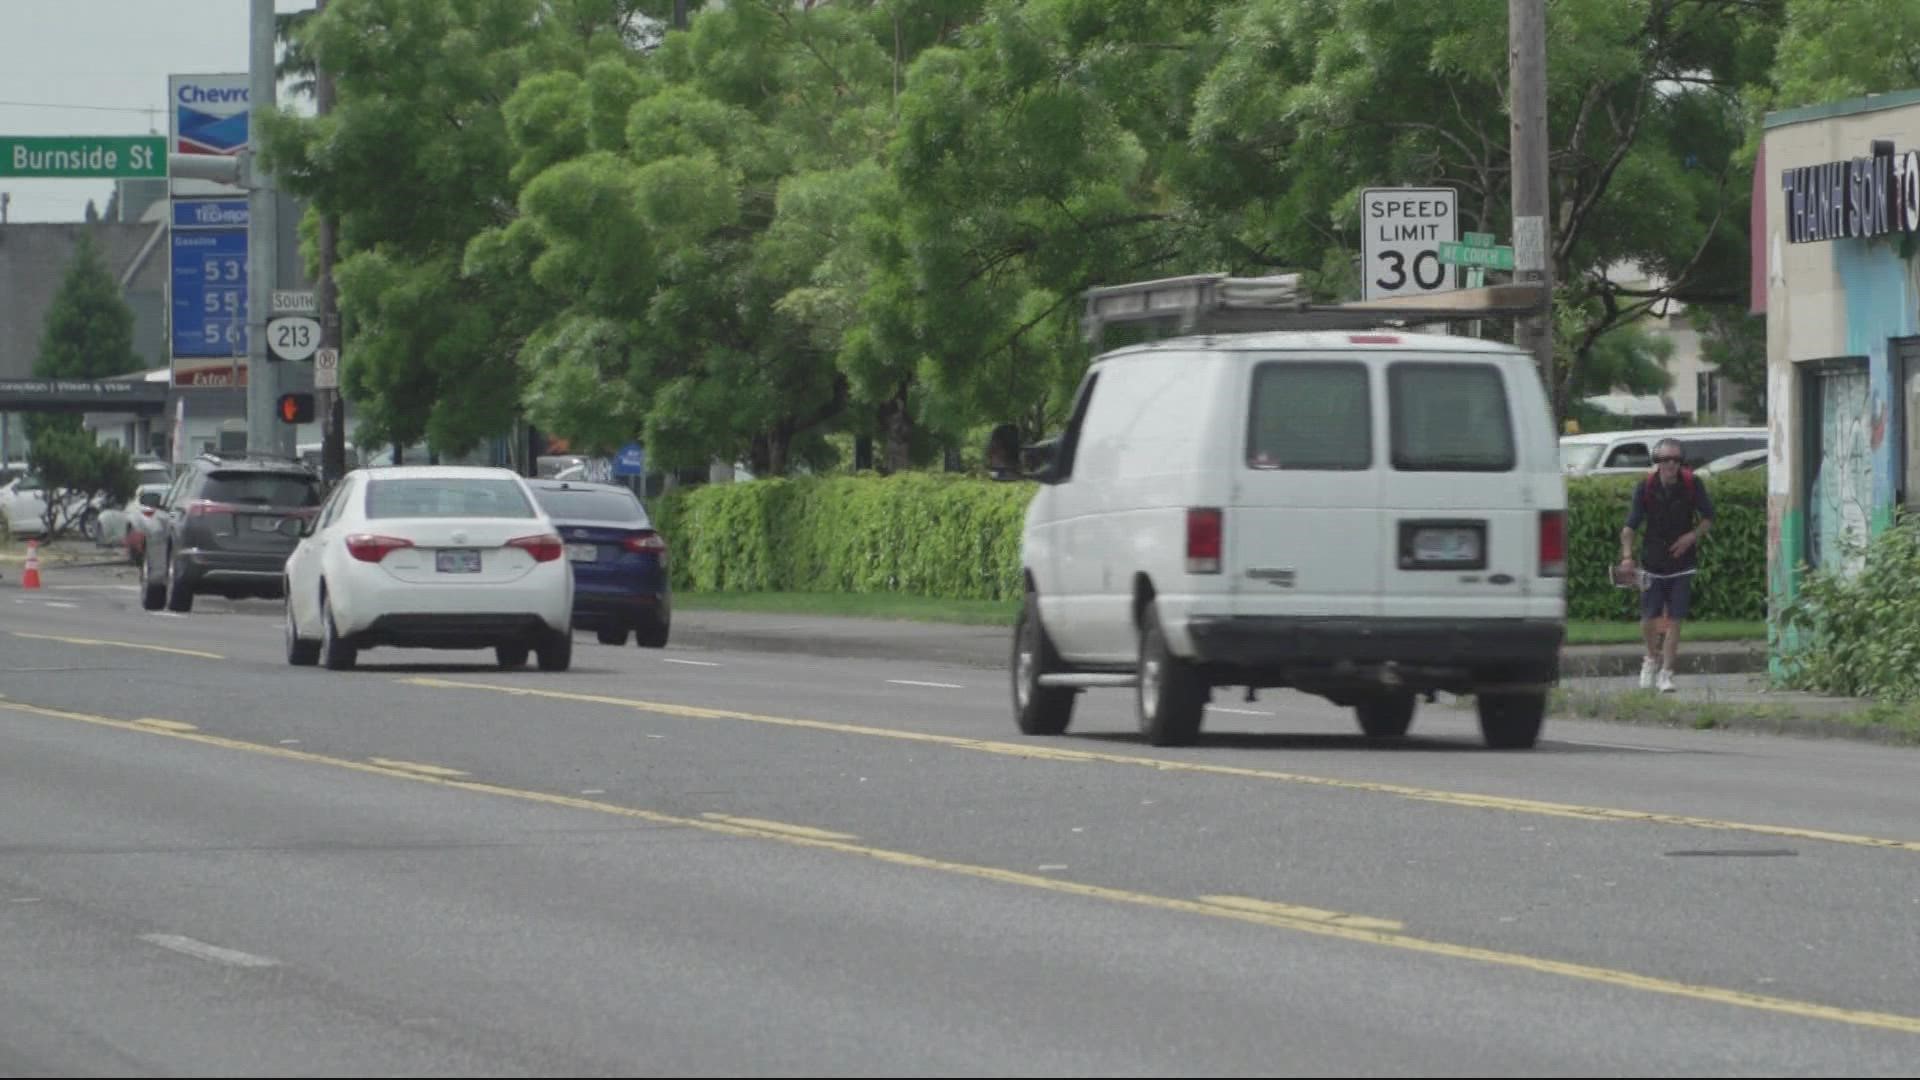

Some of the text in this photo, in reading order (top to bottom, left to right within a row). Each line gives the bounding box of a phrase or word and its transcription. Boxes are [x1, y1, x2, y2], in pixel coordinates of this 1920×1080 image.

[178, 84, 249, 104] Chevro
[12, 145, 154, 171] Burnside St
[1371, 201, 1448, 219] SPEED
[1783, 166, 1846, 244] THANH
[1380, 224, 1440, 242] LIMIT
[1376, 249, 1446, 291] 30
[204, 293, 248, 313] 55
[274, 295, 314, 309] SOUTH
[204, 324, 248, 344] 56
[277, 326, 311, 348] 213
